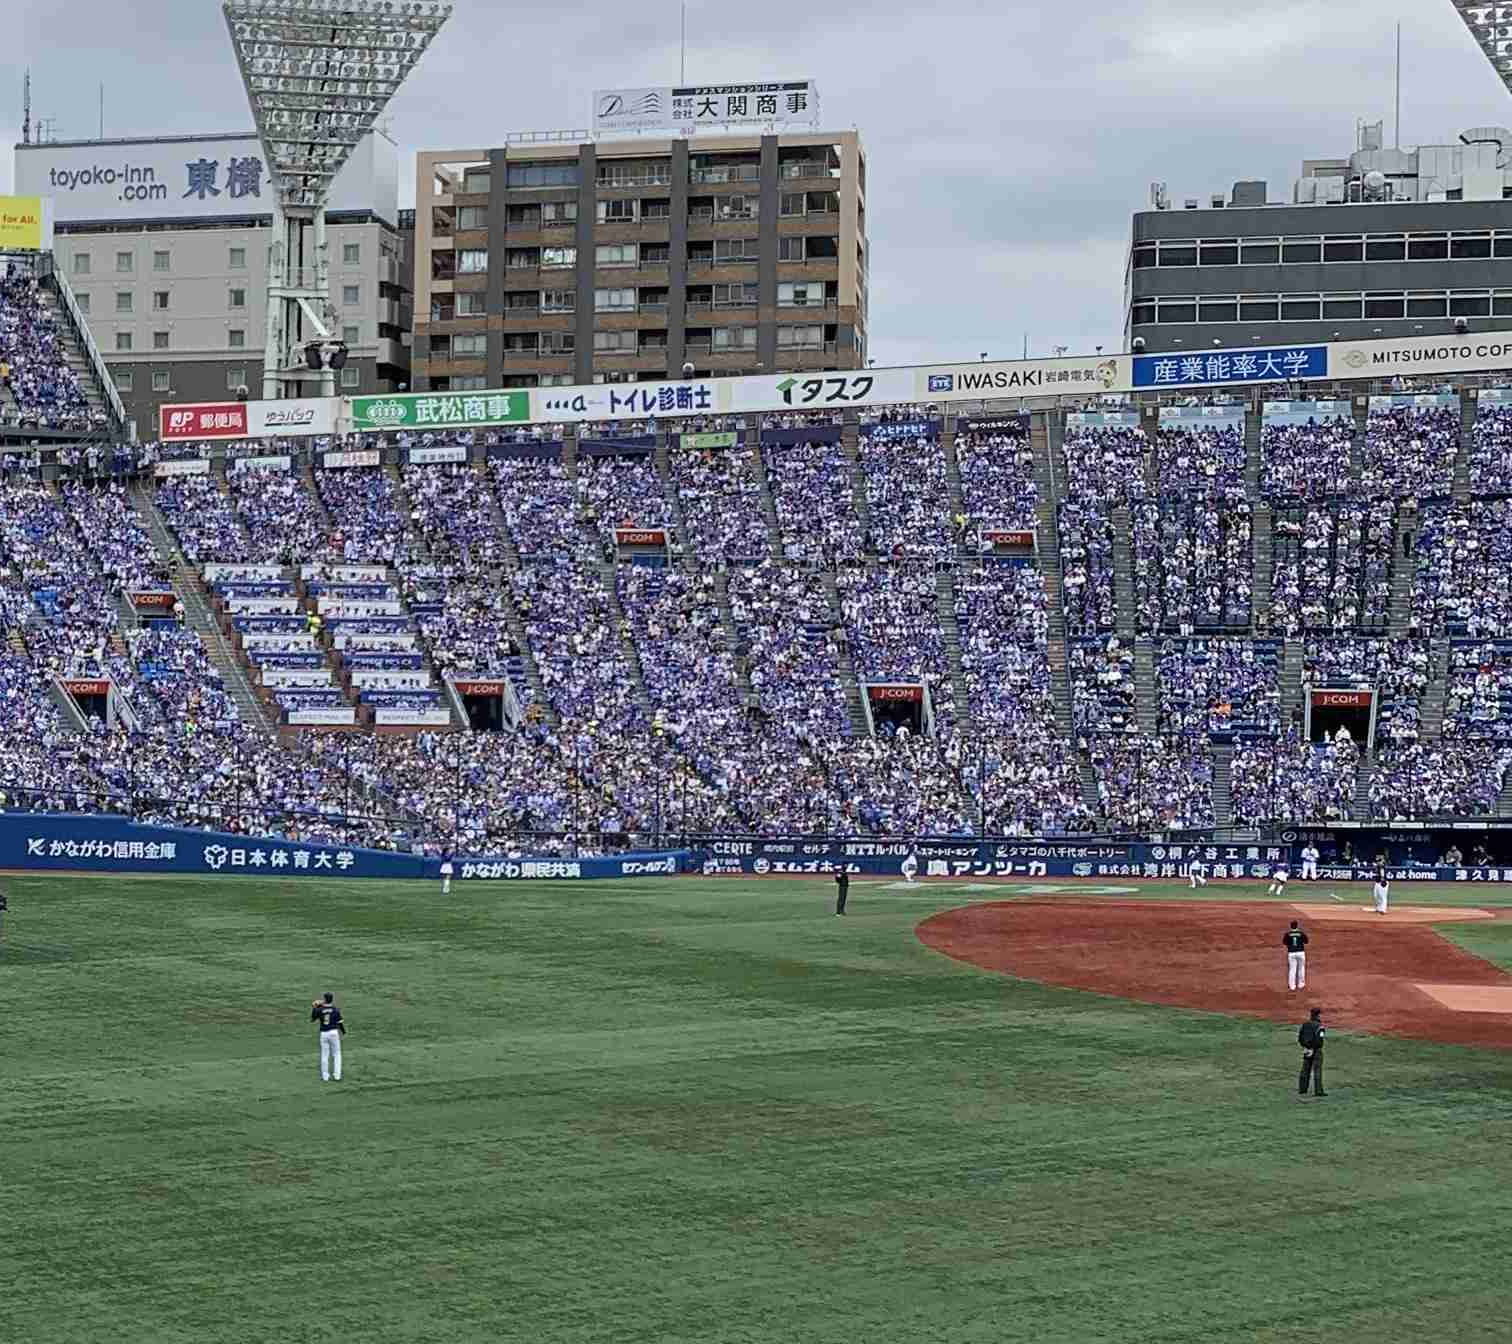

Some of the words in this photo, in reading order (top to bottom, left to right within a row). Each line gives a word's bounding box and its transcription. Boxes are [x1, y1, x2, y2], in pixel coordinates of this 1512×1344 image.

[696, 92, 809, 118] 大関商事
[49, 164, 155, 191] toyoko-inn
[117, 183, 168, 202] .com
[1371, 346, 1471, 365] MITSUMOTO
[1044, 368, 1096, 384] 岩崎電気
[1152, 350, 1311, 385] 産業能率大学
[801, 376, 873, 404] タスク
[957, 370, 1043, 391] IWASAKI
[415, 395, 512, 423] 武松商事
[609, 383, 712, 414] トイレ診断士
[199, 412, 242, 430] 郵便局
[48, 839, 177, 860] かながわ信用金庫
[230, 848, 355, 870] 日本体育大学
[461, 861, 581, 879] かながわ県民共済
[772, 860, 861, 873] エムズホーム
